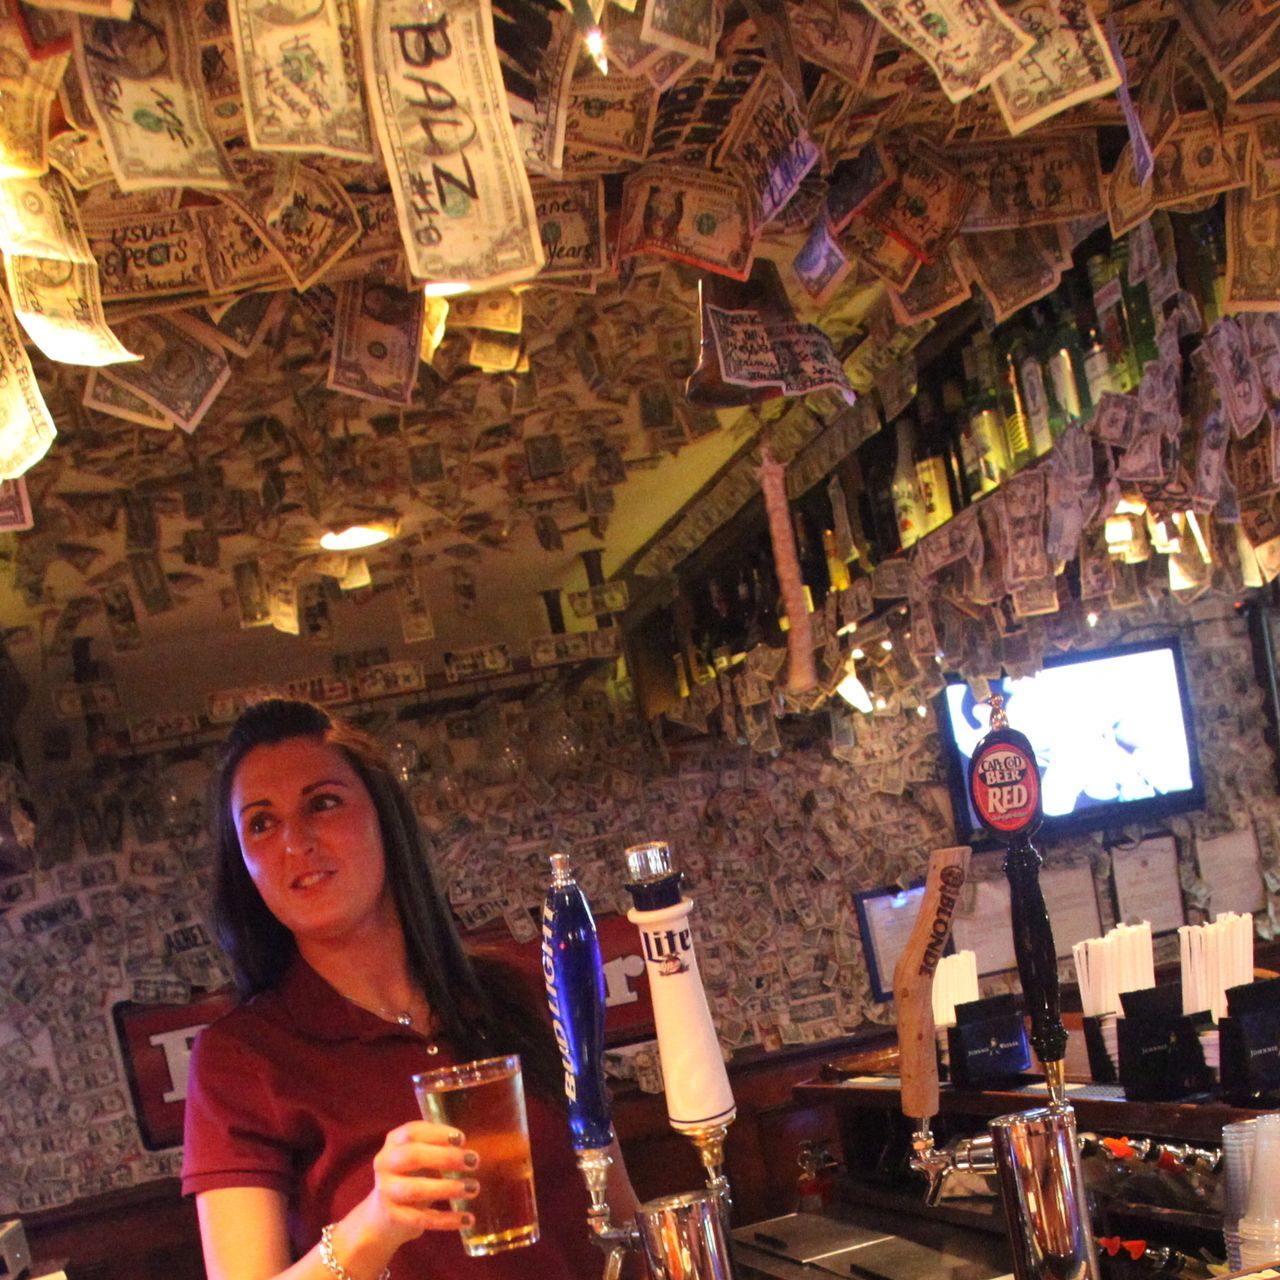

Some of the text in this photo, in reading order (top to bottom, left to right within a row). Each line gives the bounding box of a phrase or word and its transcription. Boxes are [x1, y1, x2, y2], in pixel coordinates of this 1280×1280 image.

[389, 14, 479, 209] BALZ
[985, 770, 1021, 785] BEER
[987, 784, 1028, 814] RED
[918, 893, 956, 977] BLONDE
[542, 905, 578, 1104] BUD LIGHT
